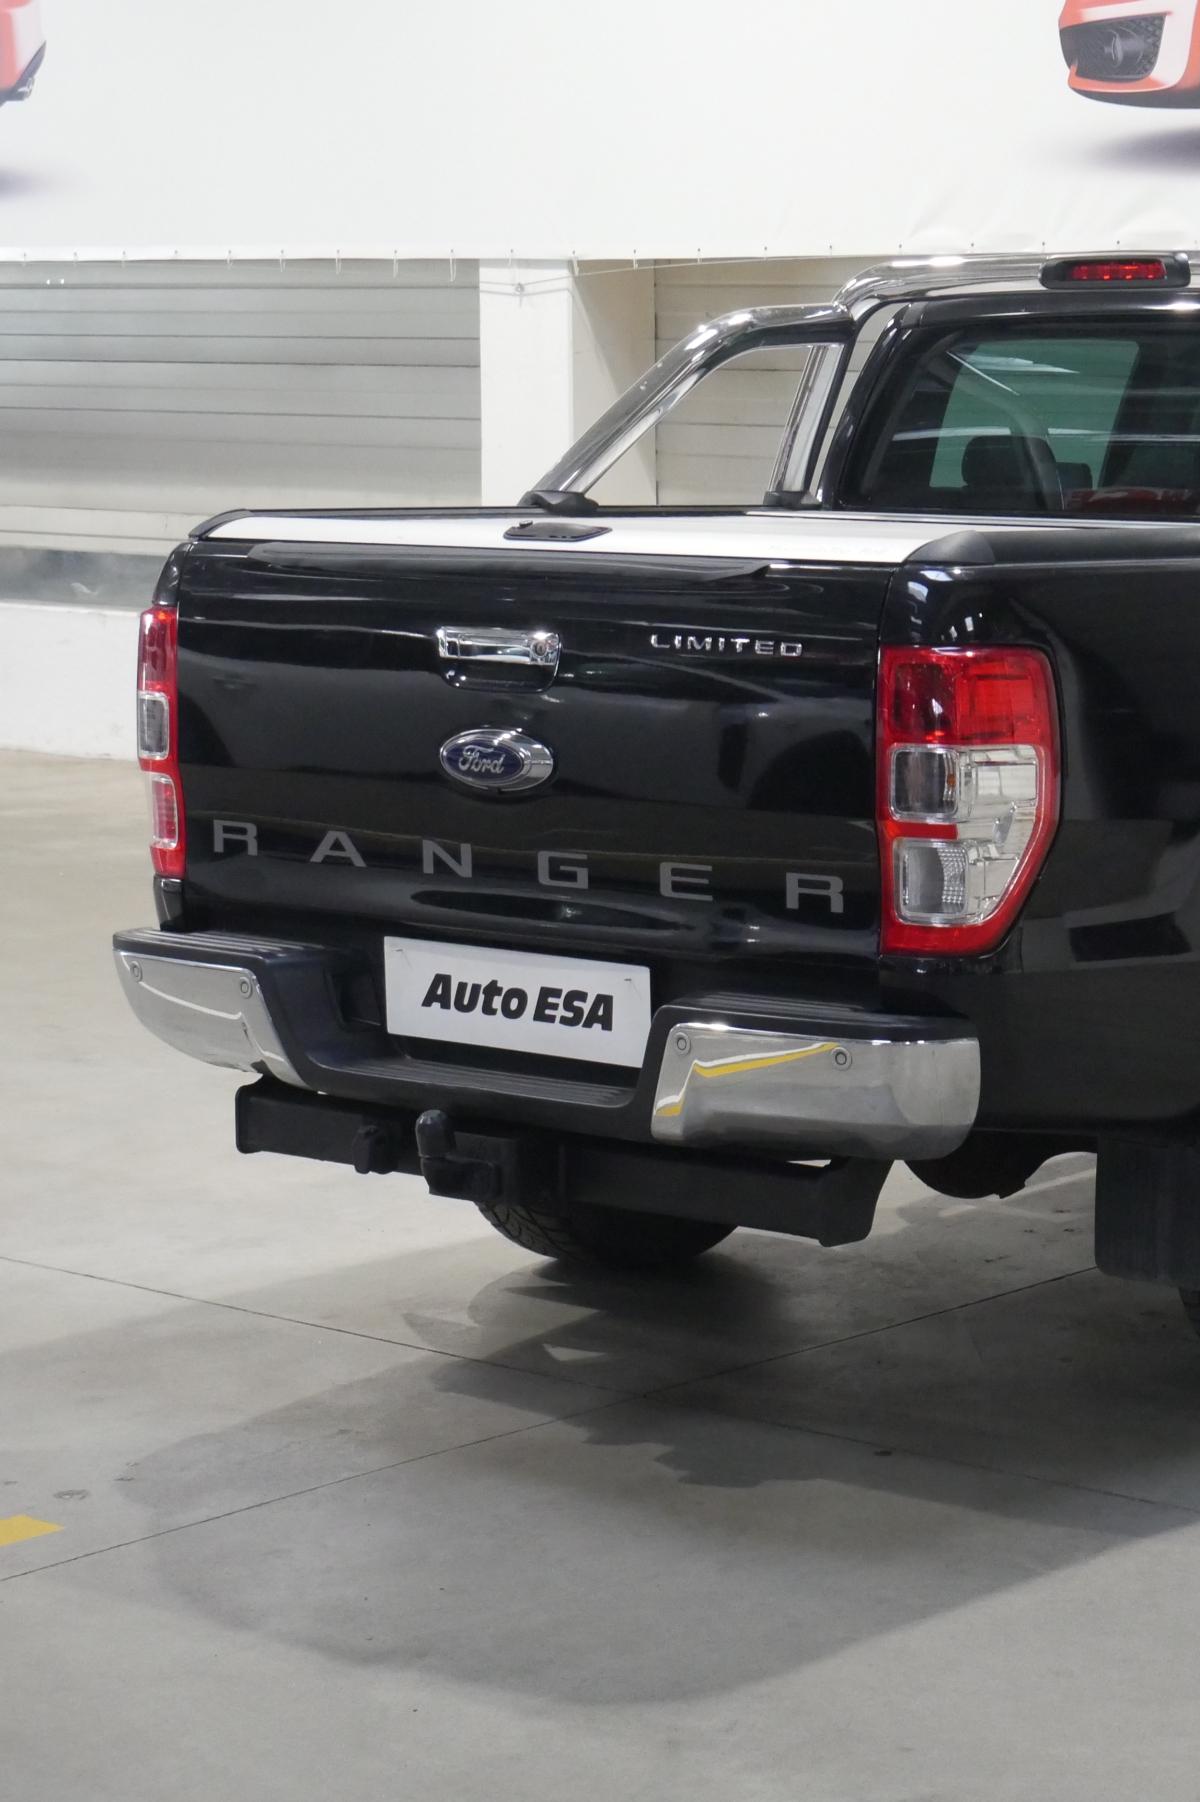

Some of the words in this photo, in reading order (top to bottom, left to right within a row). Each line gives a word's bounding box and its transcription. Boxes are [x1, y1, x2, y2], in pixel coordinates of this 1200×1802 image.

[651, 634, 803, 657] LIMITED
[458, 744, 506, 774] Ford
[213, 819, 844, 914] RANGER
[421, 973, 528, 1019] Auto
[533, 986, 614, 1032] ESA
